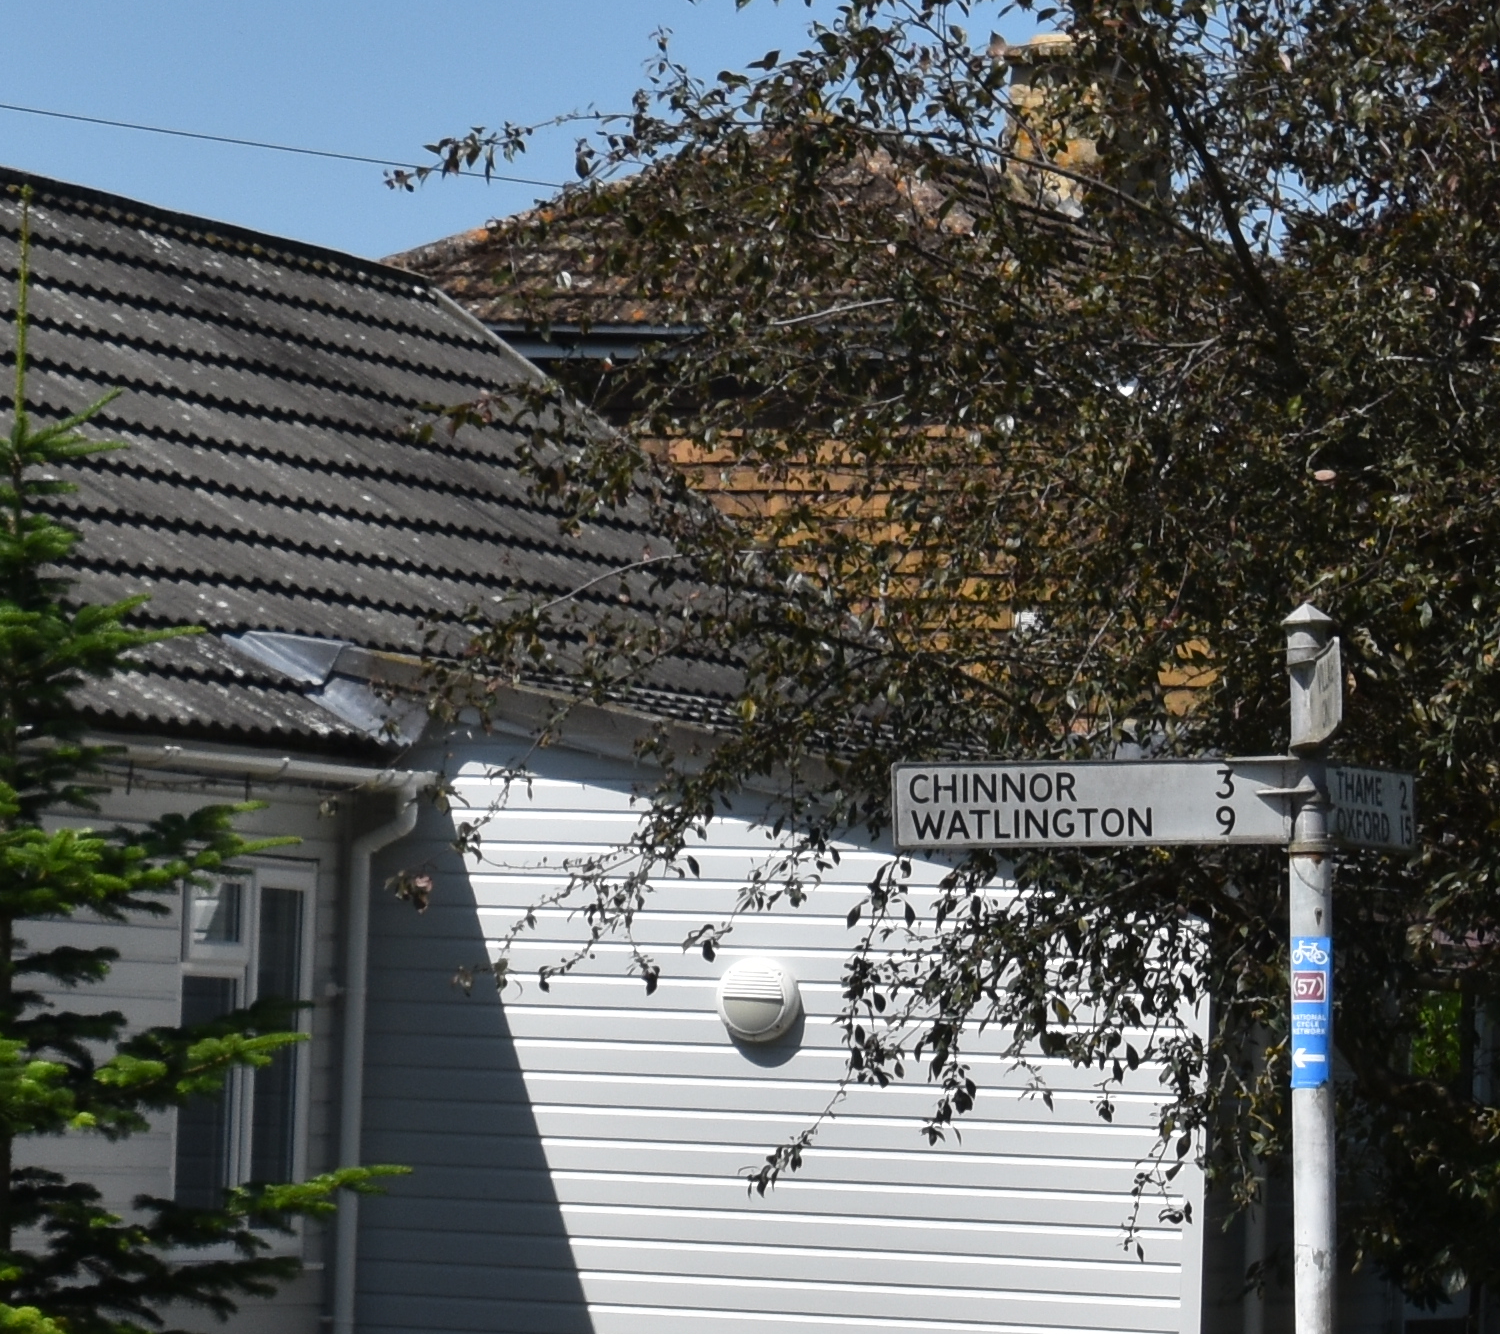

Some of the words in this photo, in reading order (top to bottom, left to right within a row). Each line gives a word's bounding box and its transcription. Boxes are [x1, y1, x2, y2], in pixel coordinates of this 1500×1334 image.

[909, 772, 1077, 804] CHINNOR
[1216, 769, 1235, 800] 3
[1336, 770, 1383, 807] THAME
[1399, 780, 1407, 811] 2
[910, 807, 1153, 840] WATLINGTON
[1215, 805, 1236, 836] 9
[1337, 807, 1390, 843] OXFORD
[1400, 815, 1412, 845] 15
[1292, 1013, 1326, 1021] NATIONAL
